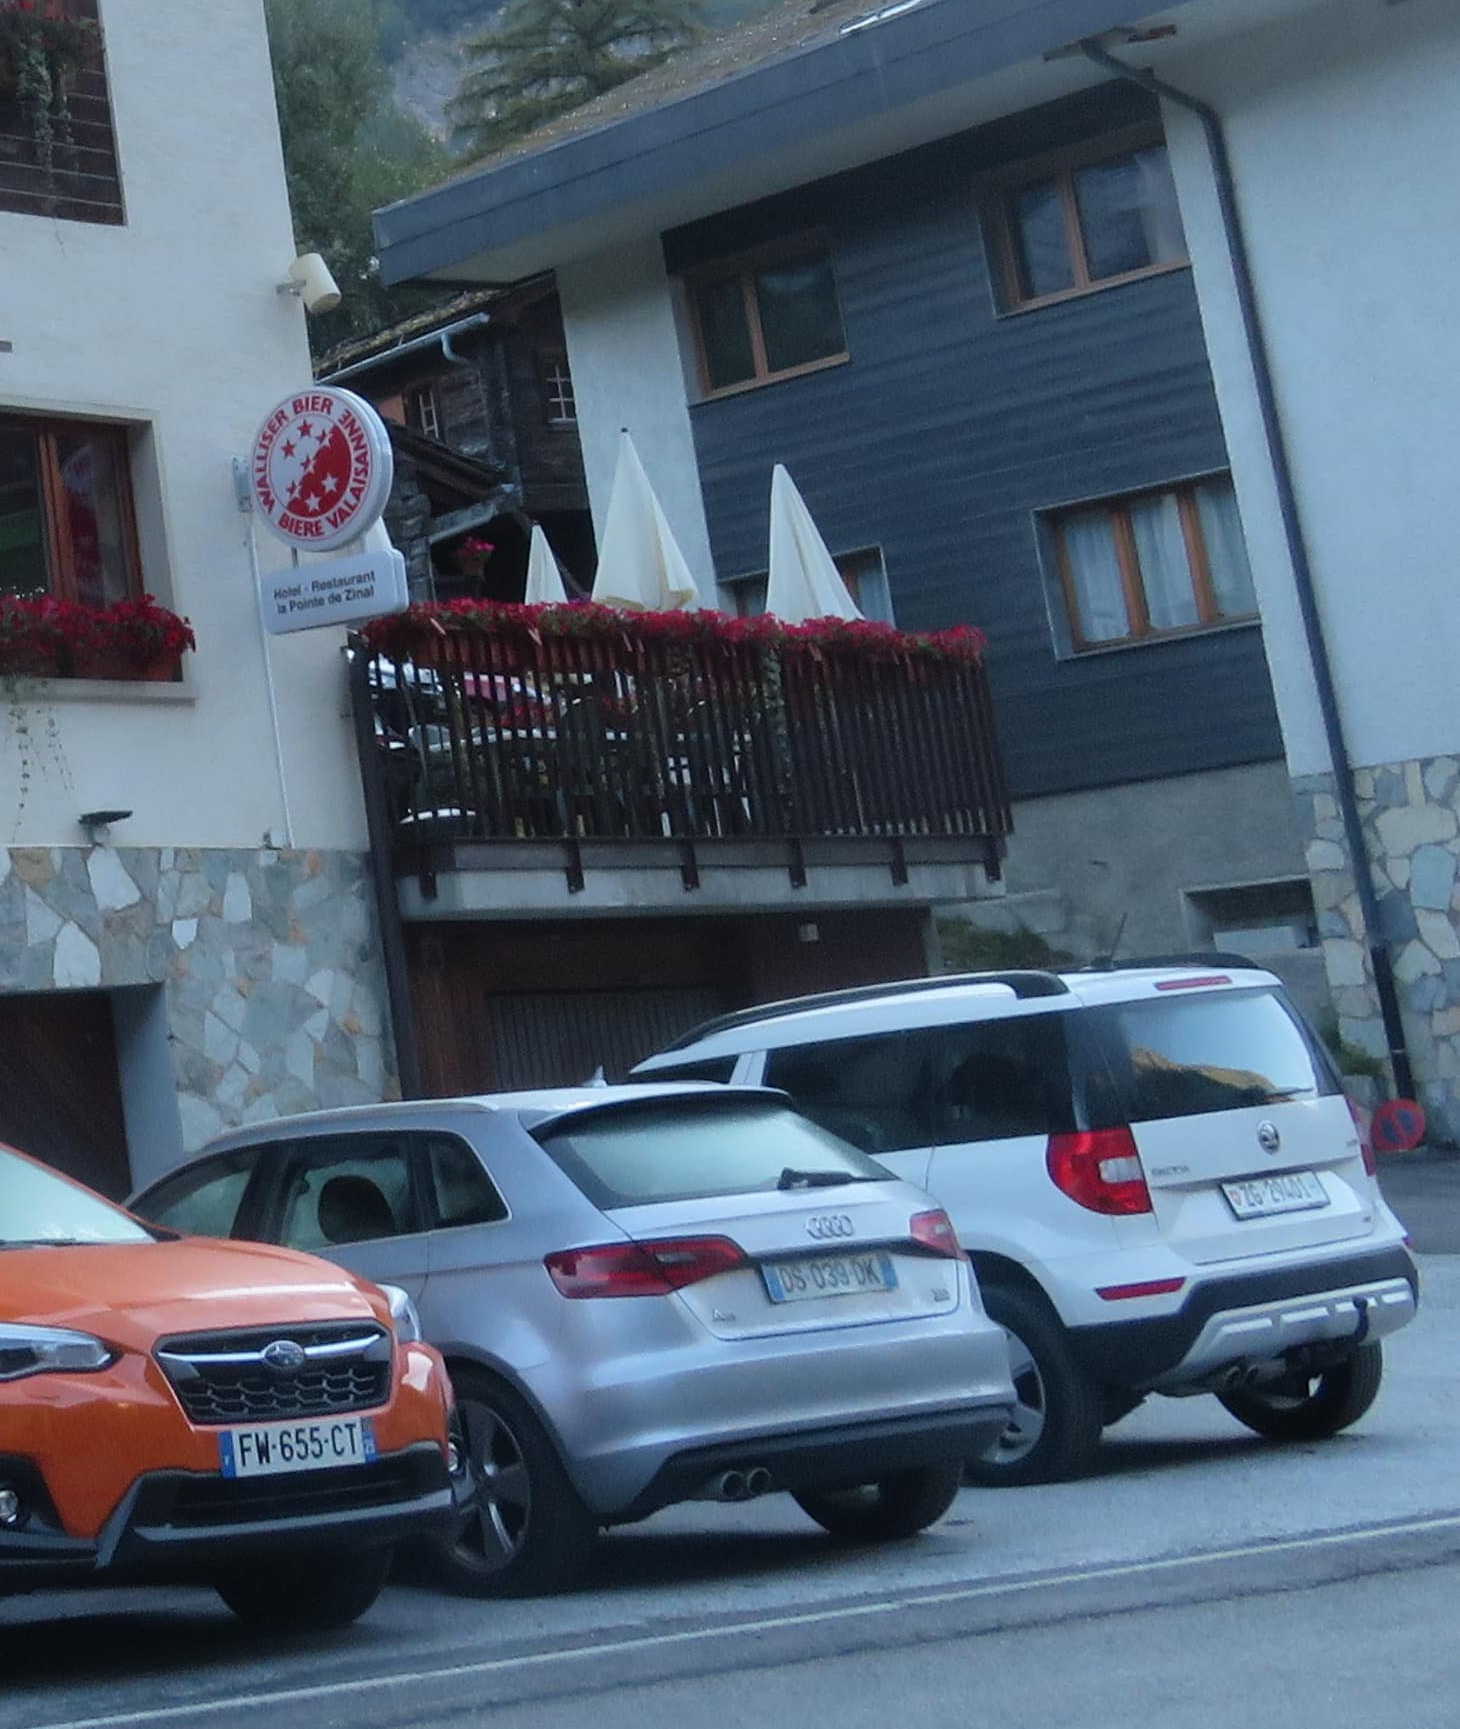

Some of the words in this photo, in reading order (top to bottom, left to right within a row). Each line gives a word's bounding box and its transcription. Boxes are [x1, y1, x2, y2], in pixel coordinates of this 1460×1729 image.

[254, 410, 289, 515] WALLISER
[292, 395, 334, 416] BIER
[327, 409, 371, 529] VALAISANNE
[289, 597, 325, 612] Pointe
[327, 592, 342, 604] de
[344, 585, 375, 602] Zinal
[312, 570, 376, 592] Restaurant
[238, 1422, 357, 1468] FW-655-CT
